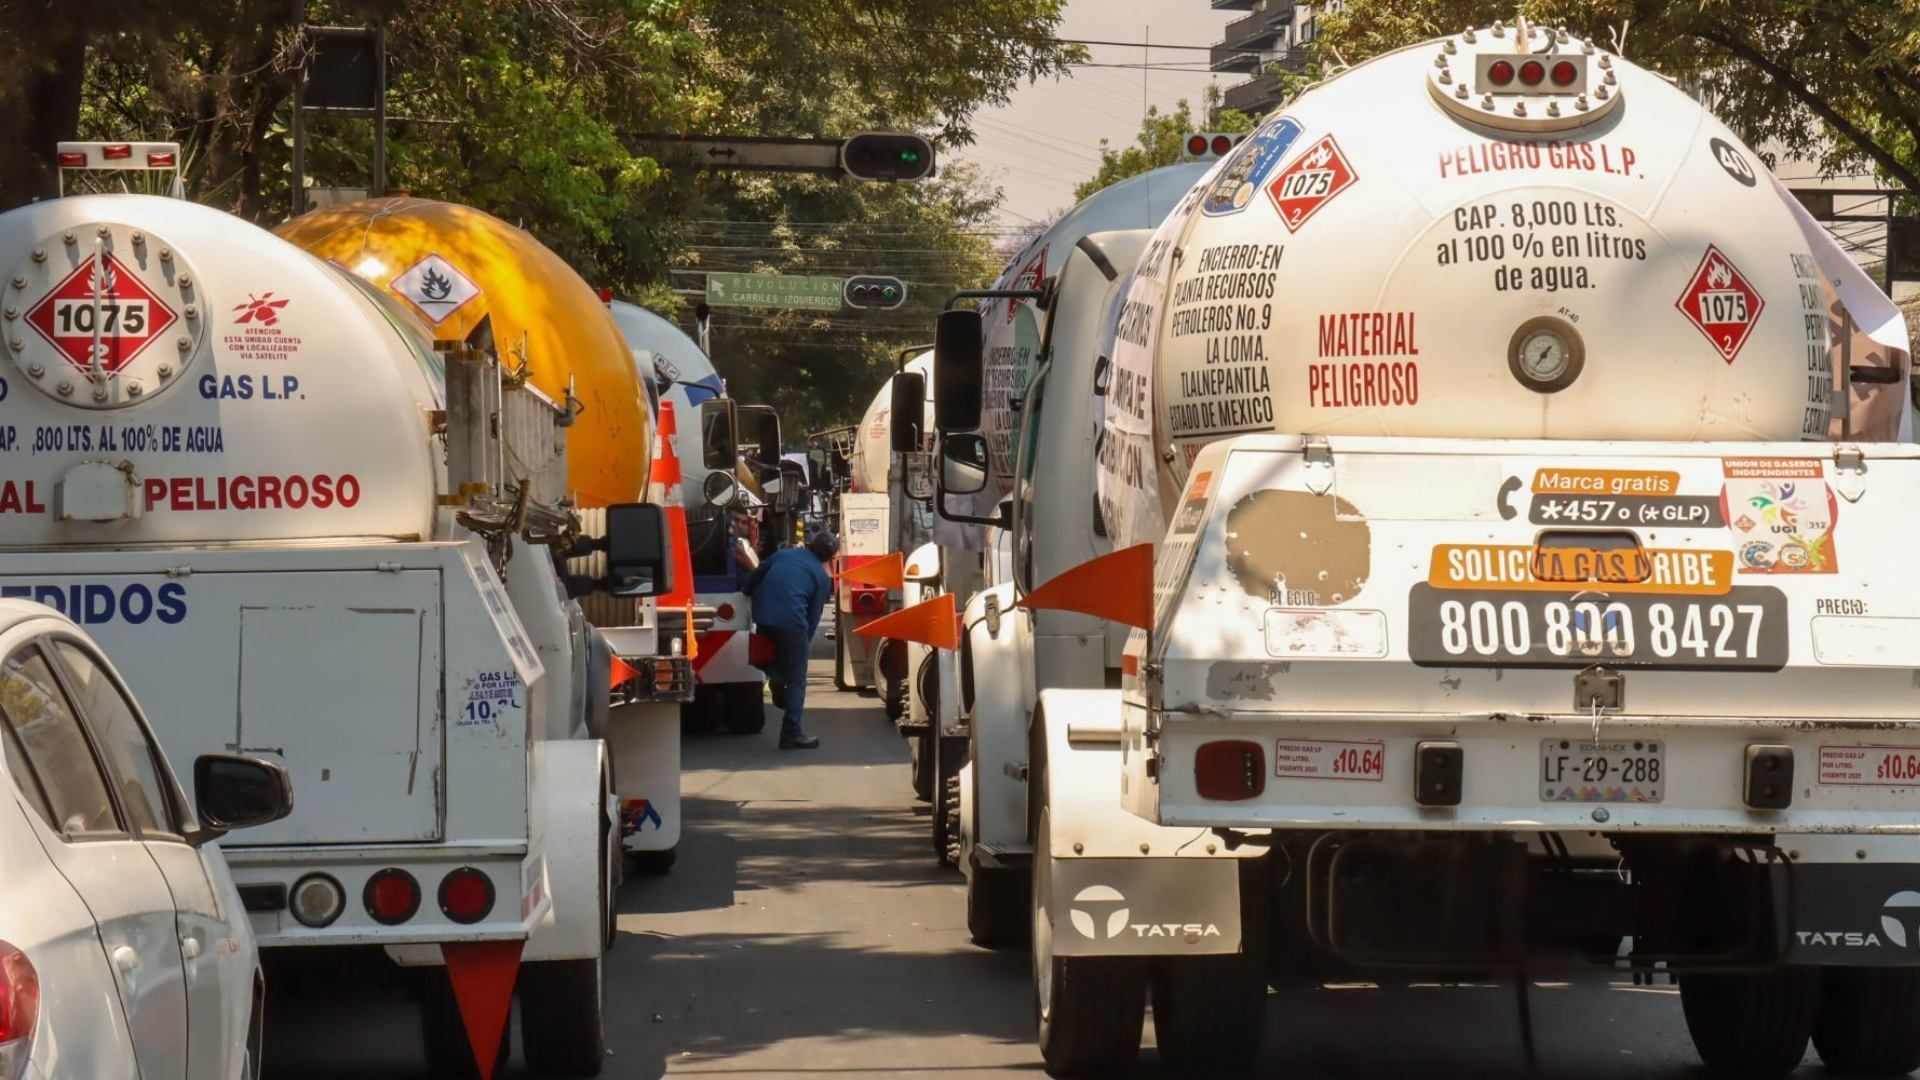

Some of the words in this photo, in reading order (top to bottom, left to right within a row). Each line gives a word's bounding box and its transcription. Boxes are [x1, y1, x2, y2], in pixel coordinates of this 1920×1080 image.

[1439, 141, 1541, 179] PELIGRO
[1549, 141, 1596, 171] GAS
[1600, 144, 1645, 180] L.P.
[1719, 146, 1753, 179] 40
[1283, 172, 1331, 198] 1075
[1291, 207, 1302, 224] 2
[1454, 204, 1504, 231] CAP.
[1512, 201, 1578, 231] 8,000
[1584, 201, 1623, 228] Lts.
[1437, 238, 1458, 265] al
[1464, 234, 1505, 262] 100
[1513, 233, 1544, 259] %
[1552, 235, 1582, 258] en
[1586, 231, 1647, 261] litros
[732, 278, 840, 292] REVOLUCION
[1173, 277, 1202, 307] PLANTA
[1205, 272, 1276, 301] RECURSOS
[1495, 265, 1523, 291] de
[1531, 265, 1596, 292] agua.
[732, 292, 778, 304] CARRILES
[784, 295, 840, 307] IZQUIERDOS
[1701, 294, 1747, 323] 1075
[57, 303, 145, 334] 1075
[245, 328, 282, 336] ATENCION
[1171, 305, 1232, 337] PETROLEROS
[224, 335, 243, 343] ESTA
[274, 336, 302, 345] CUENTA
[1318, 311, 1419, 358] MATERIAL
[1723, 335, 1732, 352] 2
[87, 343, 110, 365] 2
[229, 344, 245, 352] CON
[246, 344, 298, 353] LOCALIZADOR
[240, 352, 253, 360] VIA
[1206, 337, 1220, 364] LA
[1224, 335, 1269, 362] LOMA.
[199, 373, 254, 400] GAS
[262, 374, 305, 400] L.P.
[1181, 365, 1270, 398] TLALNEPANTLA
[1308, 361, 1419, 408] PELIGROSO
[1170, 402, 1200, 432] ESTADO
[1201, 401, 1217, 429] DE
[1218, 396, 1274, 428] MEXICO
[67, 426, 94, 451] LTS.
[99, 426, 117, 451] AL
[121, 424, 158, 452] 100%
[162, 426, 182, 452] DE
[186, 426, 224, 453] AGUA
[1725, 460, 1757, 468] UNION
[1760, 460, 1772, 468] DE
[1774, 460, 1820, 468] GASEROS
[1732, 468, 1816, 477] INDEPENDIENTES
[145, 473, 361, 513] PELIGROSO
[1539, 472, 1604, 490] Marca
[1611, 475, 1670, 495] gratis
[1771, 525, 1797, 535] UGI
[1574, 552, 1627, 584] GAS
[1816, 598, 1868, 615] PRECIO:
[1440, 600, 1531, 656] 800
[1544, 601, 1636, 656] 800
[1648, 602, 1764, 659] 8427
[480, 672, 501, 682] GAS
[1333, 747, 1381, 774] $10.64
[1545, 756, 1660, 783] LF-29-288
[1130, 923, 1221, 937] TATSA
[1796, 930, 1881, 947] TATSA
